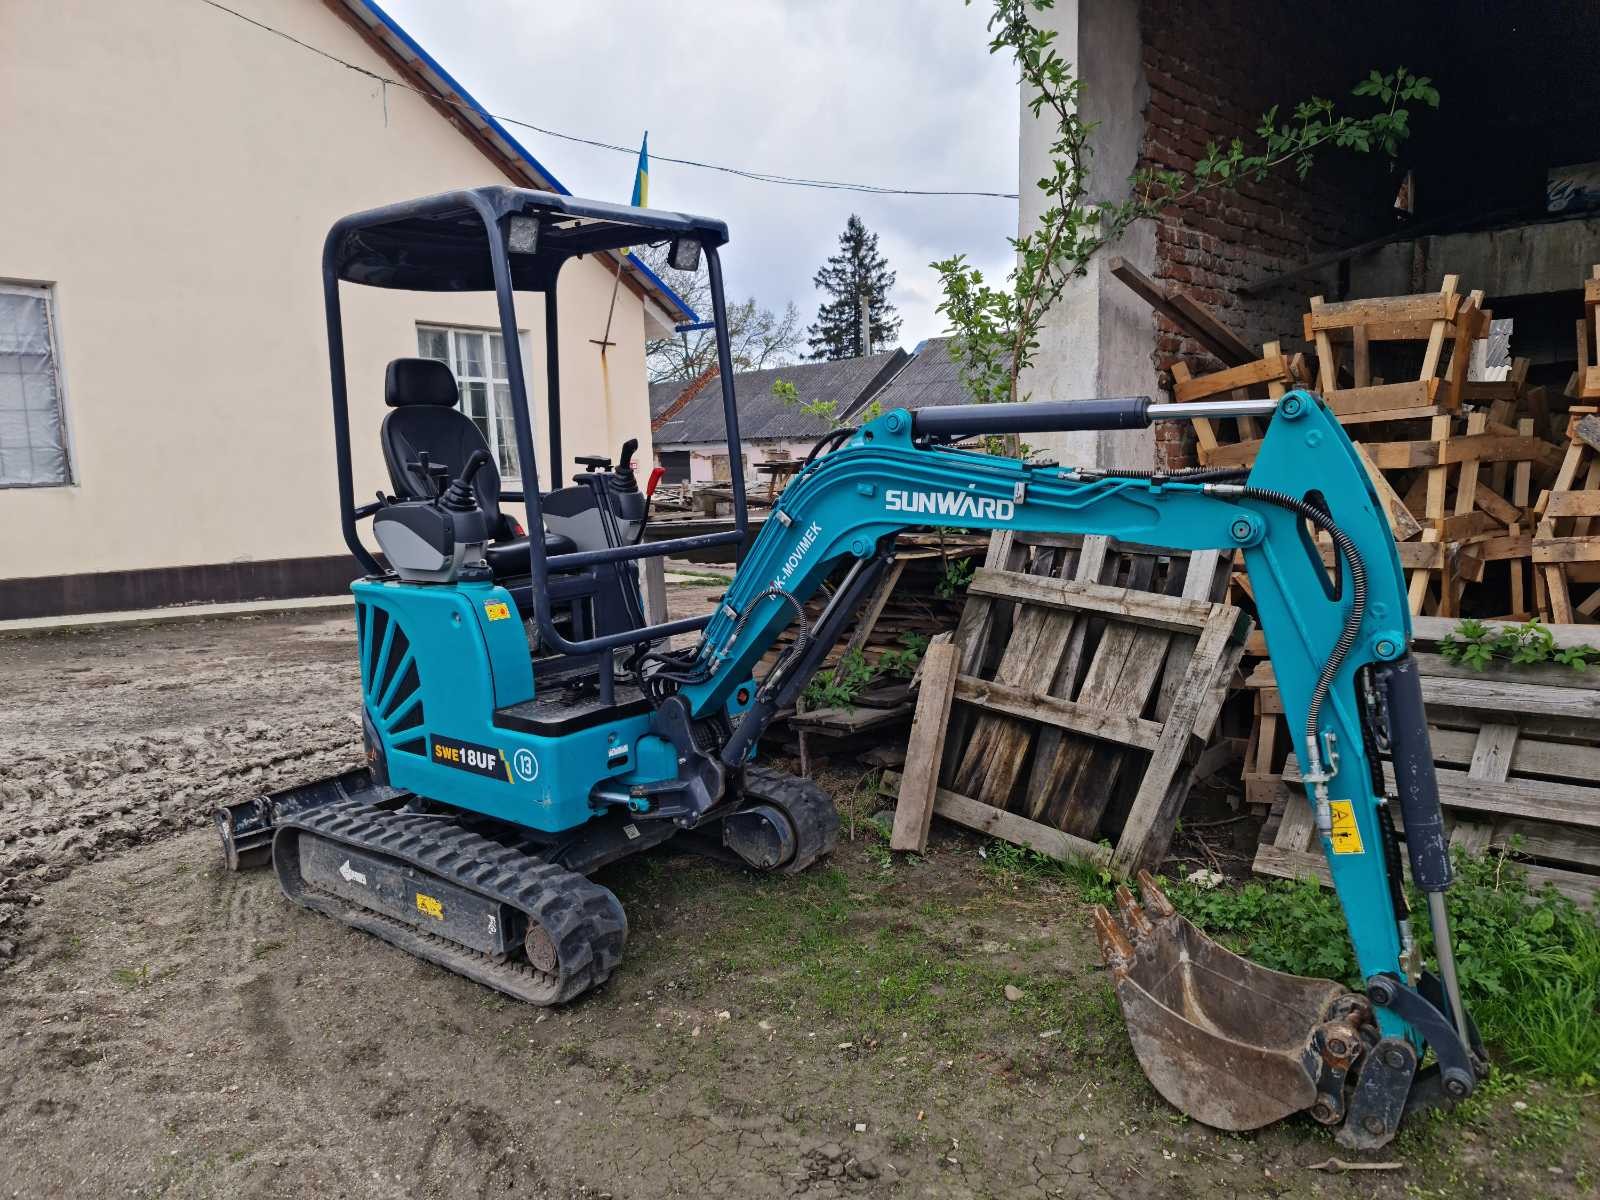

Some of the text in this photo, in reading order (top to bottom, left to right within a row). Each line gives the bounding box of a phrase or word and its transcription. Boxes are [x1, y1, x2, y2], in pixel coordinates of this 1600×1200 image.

[885, 484, 1015, 521] SUNWARD
[435, 744, 496, 771] SWE18UF
[520, 755, 532, 775] 13
